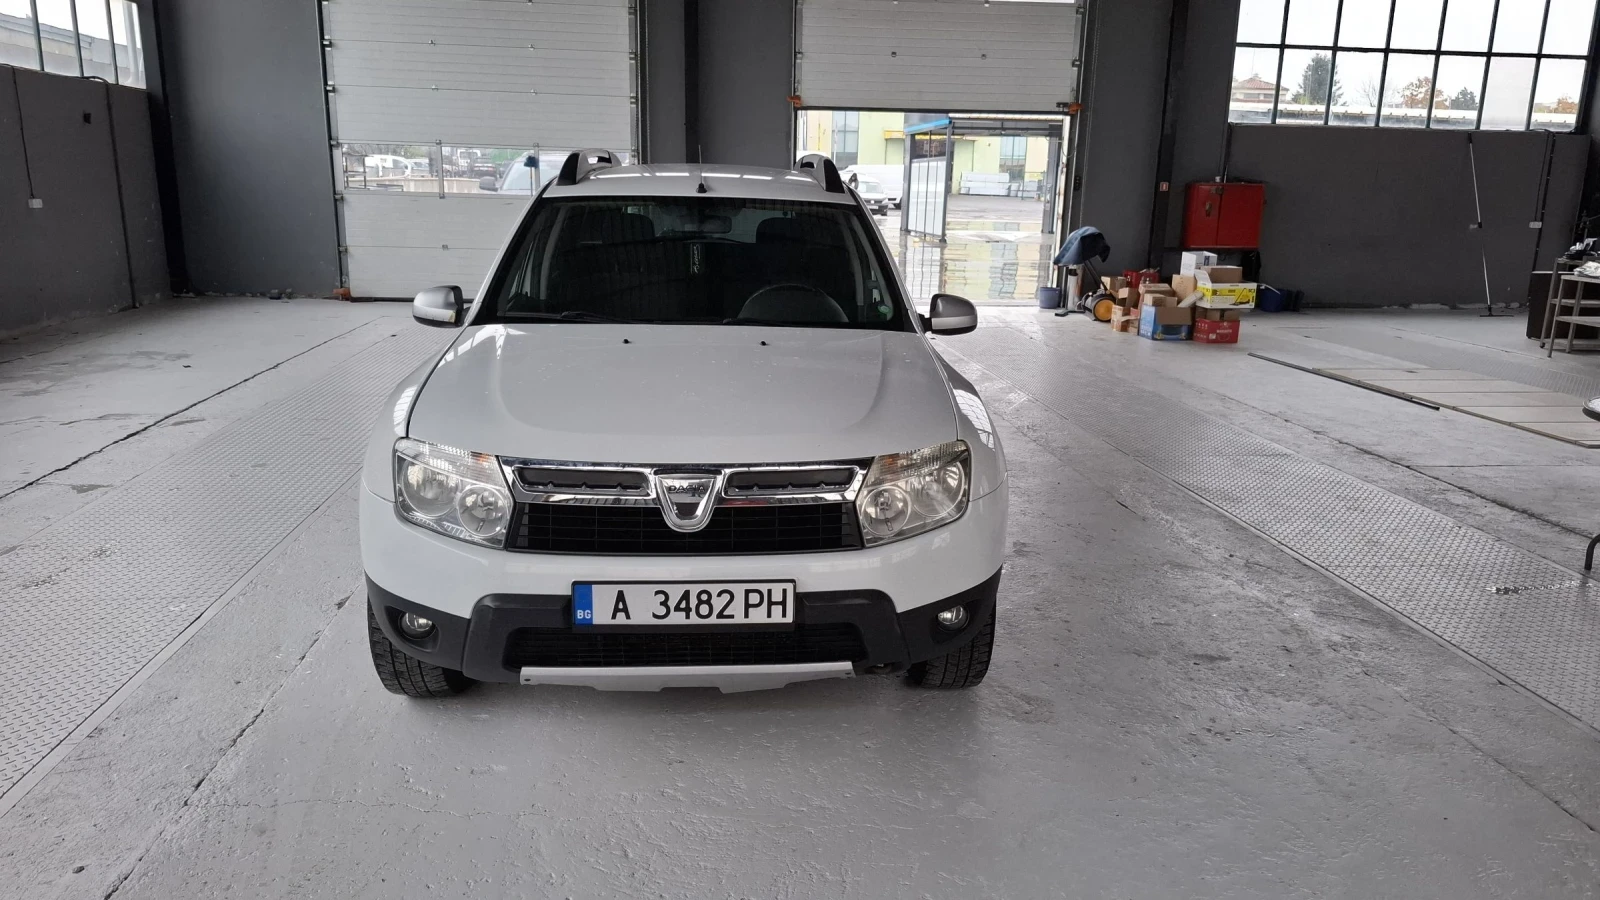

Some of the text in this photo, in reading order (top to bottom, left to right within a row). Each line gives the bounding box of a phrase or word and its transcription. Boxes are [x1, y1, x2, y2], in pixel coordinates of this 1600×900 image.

[577, 609, 591, 619] BG
[611, 588, 788, 620] A 3482 PH
